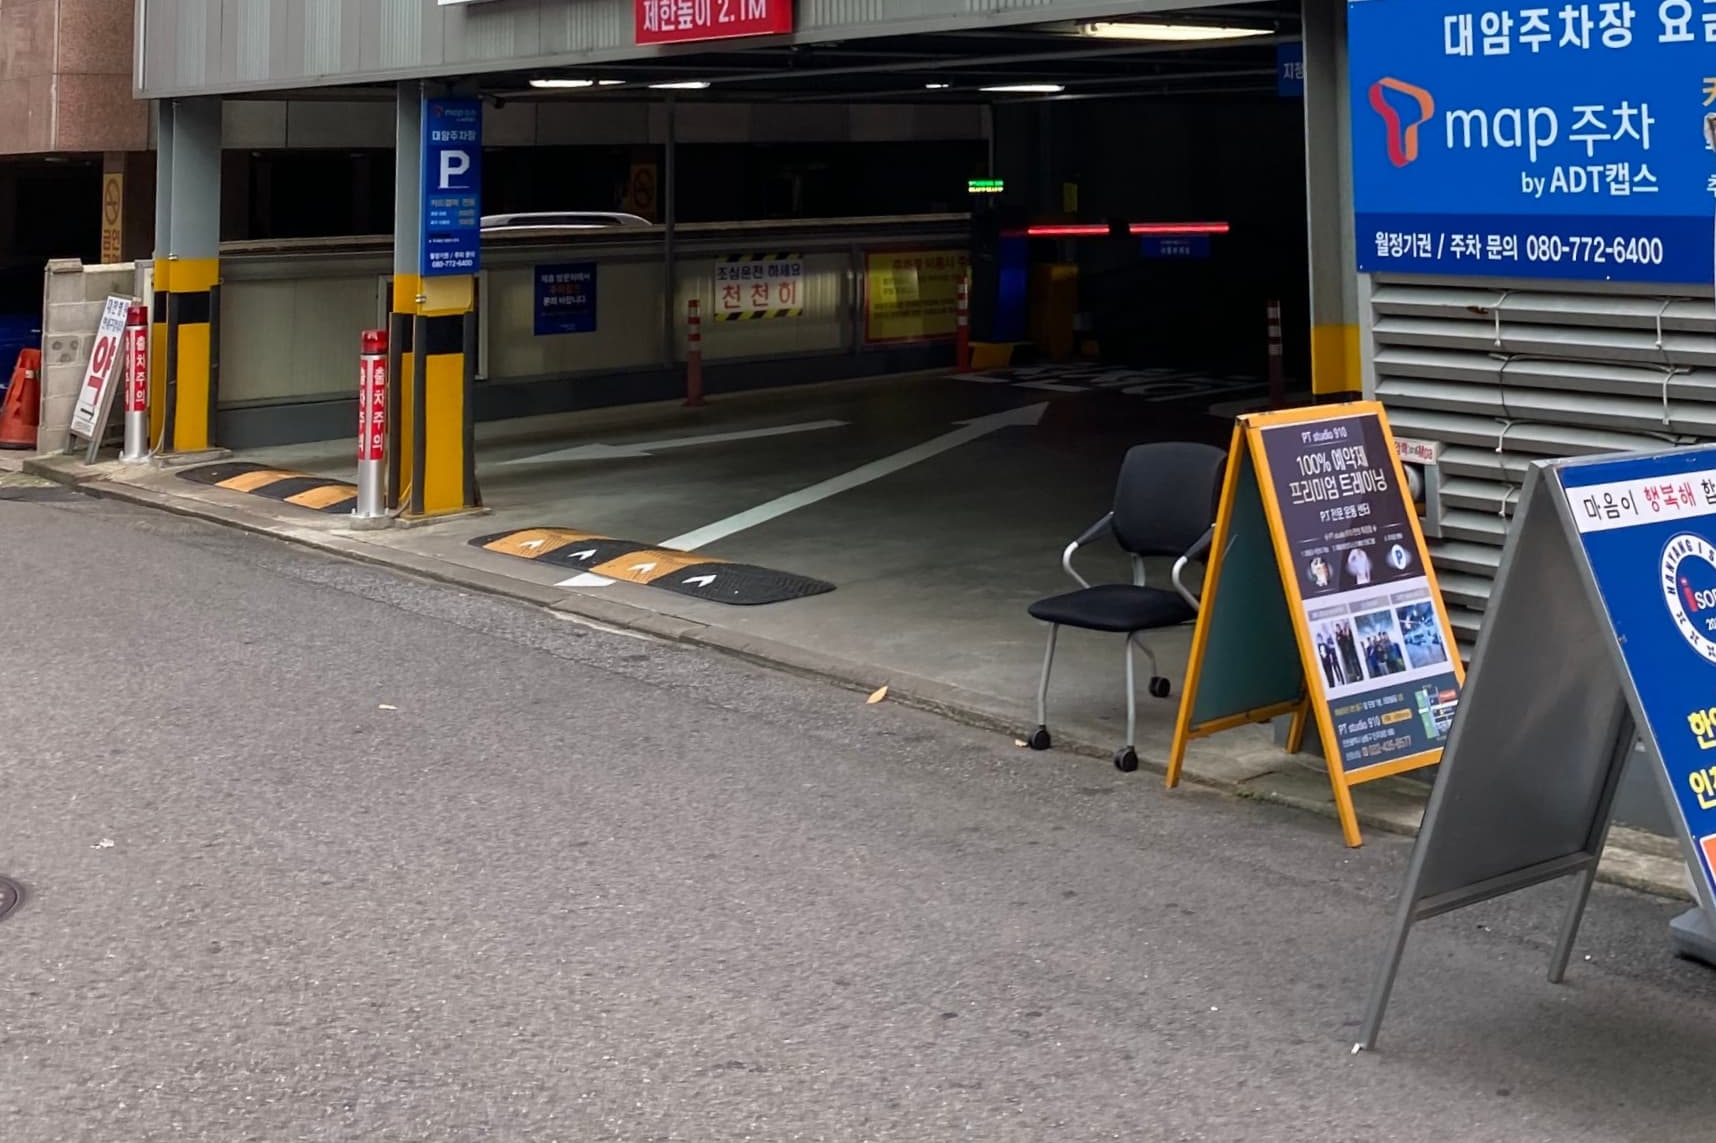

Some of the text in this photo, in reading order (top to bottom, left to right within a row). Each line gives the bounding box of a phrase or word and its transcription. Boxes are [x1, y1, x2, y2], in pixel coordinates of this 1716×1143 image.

[1444, 1, 1636, 56] 대암주차장
[432, 130, 476, 142] 대암주차장
[1445, 105, 1558, 163] map
[1568, 100, 1655, 158] 주차
[439, 149, 470, 189] P
[1521, 162, 1659, 199] by ADT캡스
[1375, 231, 1432, 258] 월정기권
[1450, 233, 1481, 259] 주차
[1486, 234, 1518, 261] 문의
[1526, 235, 1663, 265] 080-772-6400
[372, 367, 385, 452] 출차주의
[1301, 431, 1312, 444] PT
[1296, 452, 1332, 477] 100%
[1331, 445, 1369, 471] 예약제
[1289, 468, 1388, 505] 프리미엄 트레이닝
[1583, 488, 1639, 520] 마음이
[1643, 481, 1697, 513] 행복해
[1665, 539, 1694, 596] HANYANG
